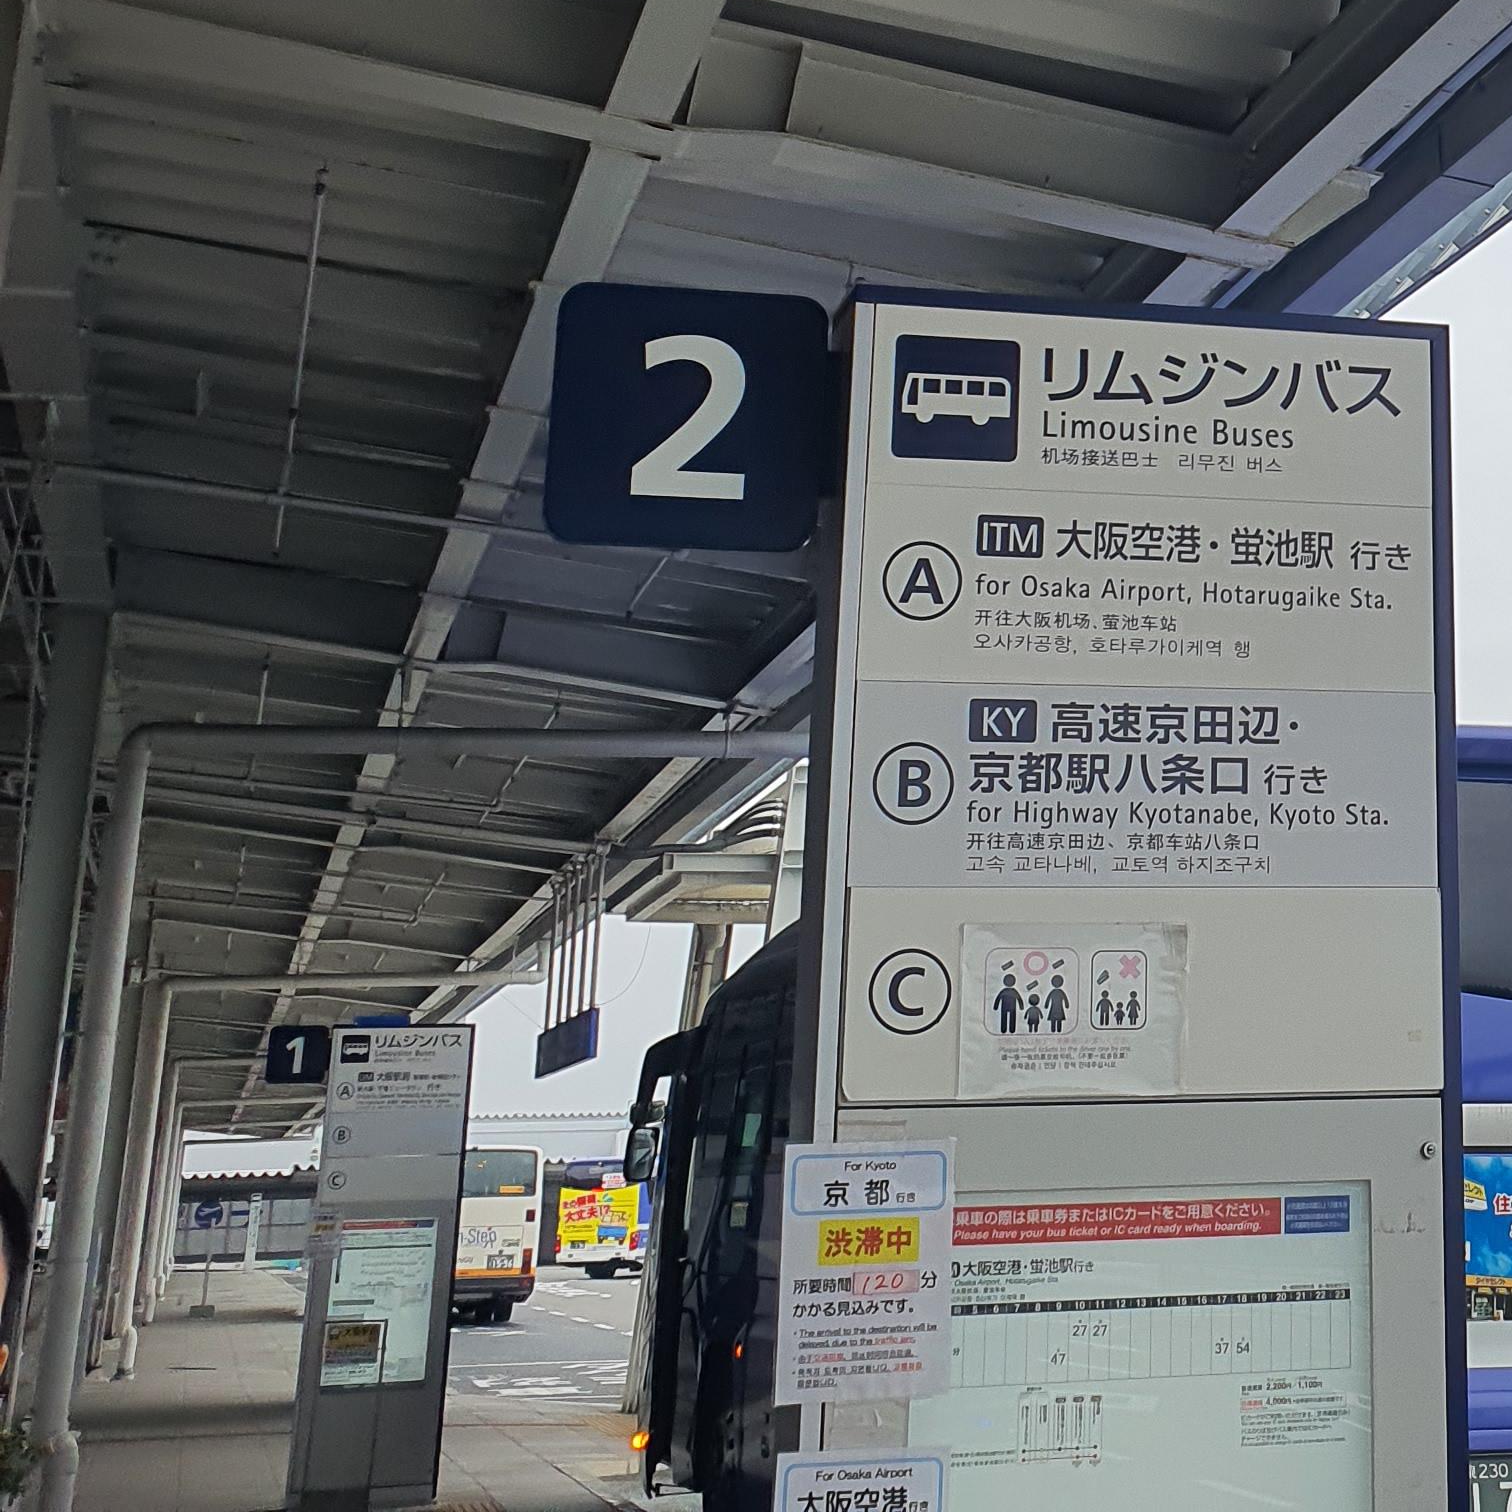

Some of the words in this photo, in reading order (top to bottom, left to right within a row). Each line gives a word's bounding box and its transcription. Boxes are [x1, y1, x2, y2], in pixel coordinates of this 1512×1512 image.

[1043, 348, 1402, 417] リムジンバス
[630, 334, 747, 501] 2
[1042, 411, 1198, 445] Limousine
[1213, 418, 1294, 449] Buses
[1042, 447, 1159, 469] 机场接送巴士
[1179, 453, 1235, 472] 리무진
[1246, 455, 1283, 473] 버스
[981, 521, 1038, 554] ITM
[1350, 540, 1412, 572] 行き
[899, 558, 944, 605] A
[975, 574, 1010, 597] for
[1021, 575, 1091, 599] Osaka
[1101, 578, 1192, 608] Airport,
[1202, 582, 1341, 612] Hotarugaike
[1350, 589, 1393, 610] Sta.
[973, 634, 1078, 655] 오사카공항,
[1089, 636, 1223, 658] 호타루가이케역
[1234, 640, 1251, 658] 행
[981, 707, 1026, 736] KY
[897, 759, 932, 807] B
[968, 753, 1250, 795] 京都駅八条口
[1263, 764, 1329, 796] 行き
[967, 801, 1002, 824] for
[1013, 801, 1118, 830] Highway
[1129, 802, 1259, 829] Kyotanabe,
[1269, 803, 1335, 830] Kyoto
[1345, 804, 1389, 826] Sta.
[966, 832, 1260, 852] 开往高速京田边、京都车站八条口
[966, 854, 1004, 874] 고속
[1013, 854, 1099, 874] 교타나베,
[1112, 854, 1168, 874] 교토역
[1177, 854, 1271, 875] 하지조구치
[888, 967, 926, 1016] C
[375, 1034, 462, 1049] リムジンバス
[285, 1037, 305, 1074] 1
[341, 1086, 350, 1096] A
[338, 1130, 346, 1140] B
[844, 1161, 861, 1171] For
[865, 1161, 897, 1171] Kyoto
[332, 1175, 340, 1186] C
[825, 1225, 912, 1258] 渋滞中
[954, 1229, 988, 1240] Please
[992, 1228, 1017, 1238] have
[1020, 1229, 1044, 1241] your
[1047, 1226, 1066, 1237] bus
[1069, 1225, 1097, 1237] ticket
[1100, 1227, 1112, 1236] or
[1114, 1224, 1126, 1234] IC
[1128, 1224, 1151, 1235] card
[1153, 1223, 1182, 1234] ready
[1185, 1222, 1212, 1232] when
[1214, 1220, 1262, 1232] boarding.
[793, 1277, 851, 1295] 所要時間
[862, 1272, 904, 1296] 120
[921, 1270, 938, 1289] 分
[792, 1298, 915, 1318] かかる見込みです。
[1014, 1303, 1021, 1312] 7
[1075, 1300, 1085, 1310] 10
[1095, 1300, 1105, 1309] 11
[1116, 1299, 1126, 1308] 12
[1136, 1298, 1146, 1308] 13
[1157, 1297, 1167, 1306] 14
[1197, 1295, 1207, 1304] 16
[1217, 1295, 1227, 1304] 17
[1237, 1294, 1247, 1303] 18
[1257, 1293, 1267, 1302] 19
[1276, 1292, 1286, 1301] 20
[1296, 1291, 1306, 1300] 21
[1315, 1291, 1326, 1300] 22
[1072, 1324, 1087, 1337] 27
[1092, 1324, 1107, 1337] 27
[1050, 1353, 1066, 1365] 47
[1215, 1342, 1229, 1354] 37
[1236, 1342, 1249, 1353] 54
[816, 1471, 834, 1482] For
[837, 1469, 871, 1481] Osaka
[1479, 1463, 1508, 1479] 230
